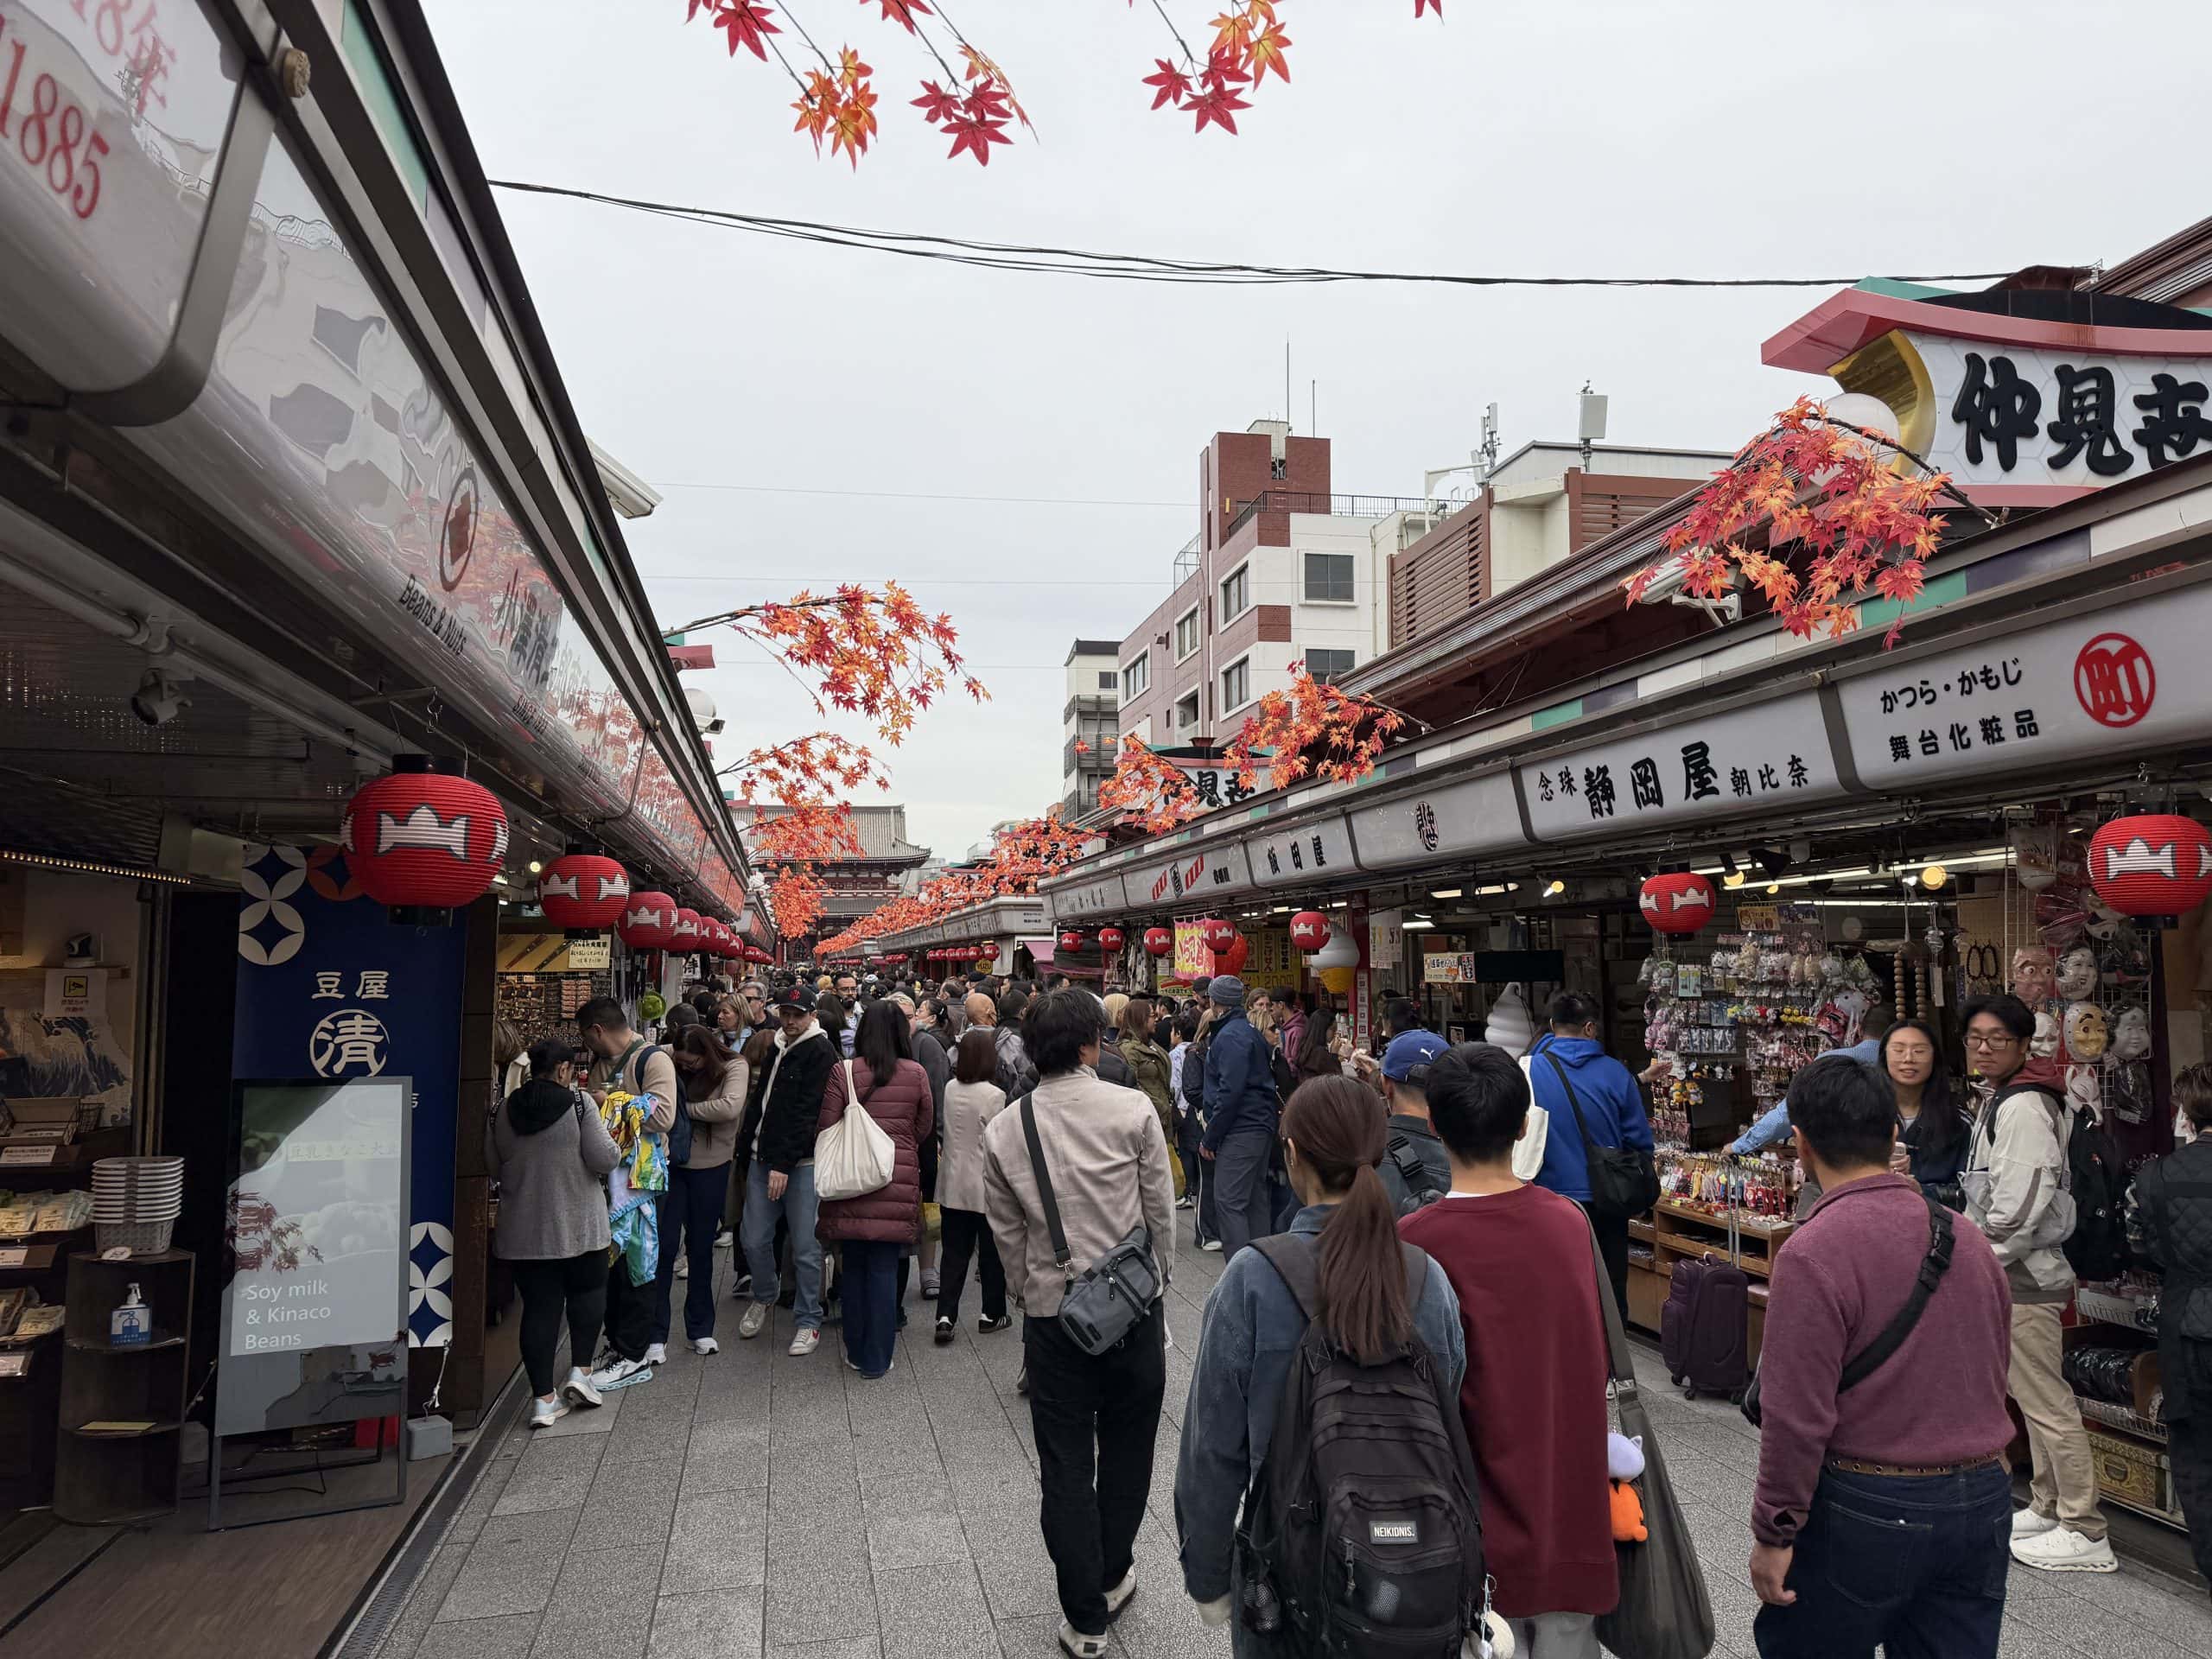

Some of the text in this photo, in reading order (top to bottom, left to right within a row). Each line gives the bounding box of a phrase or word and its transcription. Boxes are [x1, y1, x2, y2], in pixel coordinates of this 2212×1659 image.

[398, 574, 467, 656] Beans & Nuts
[1879, 658, 2023, 714] かつら・かもじ
[1888, 709, 2040, 763] 舞台化粧品
[1537, 741, 1809, 819] 念珠 静岡屋 朝比奈
[310, 969, 391, 1001] 豆屋
[316, 1014, 385, 1077] 清
[246, 1281, 328, 1303] Soy milk
[246, 1304, 332, 1325] & Kinaco
[245, 1332, 302, 1351] Beans
